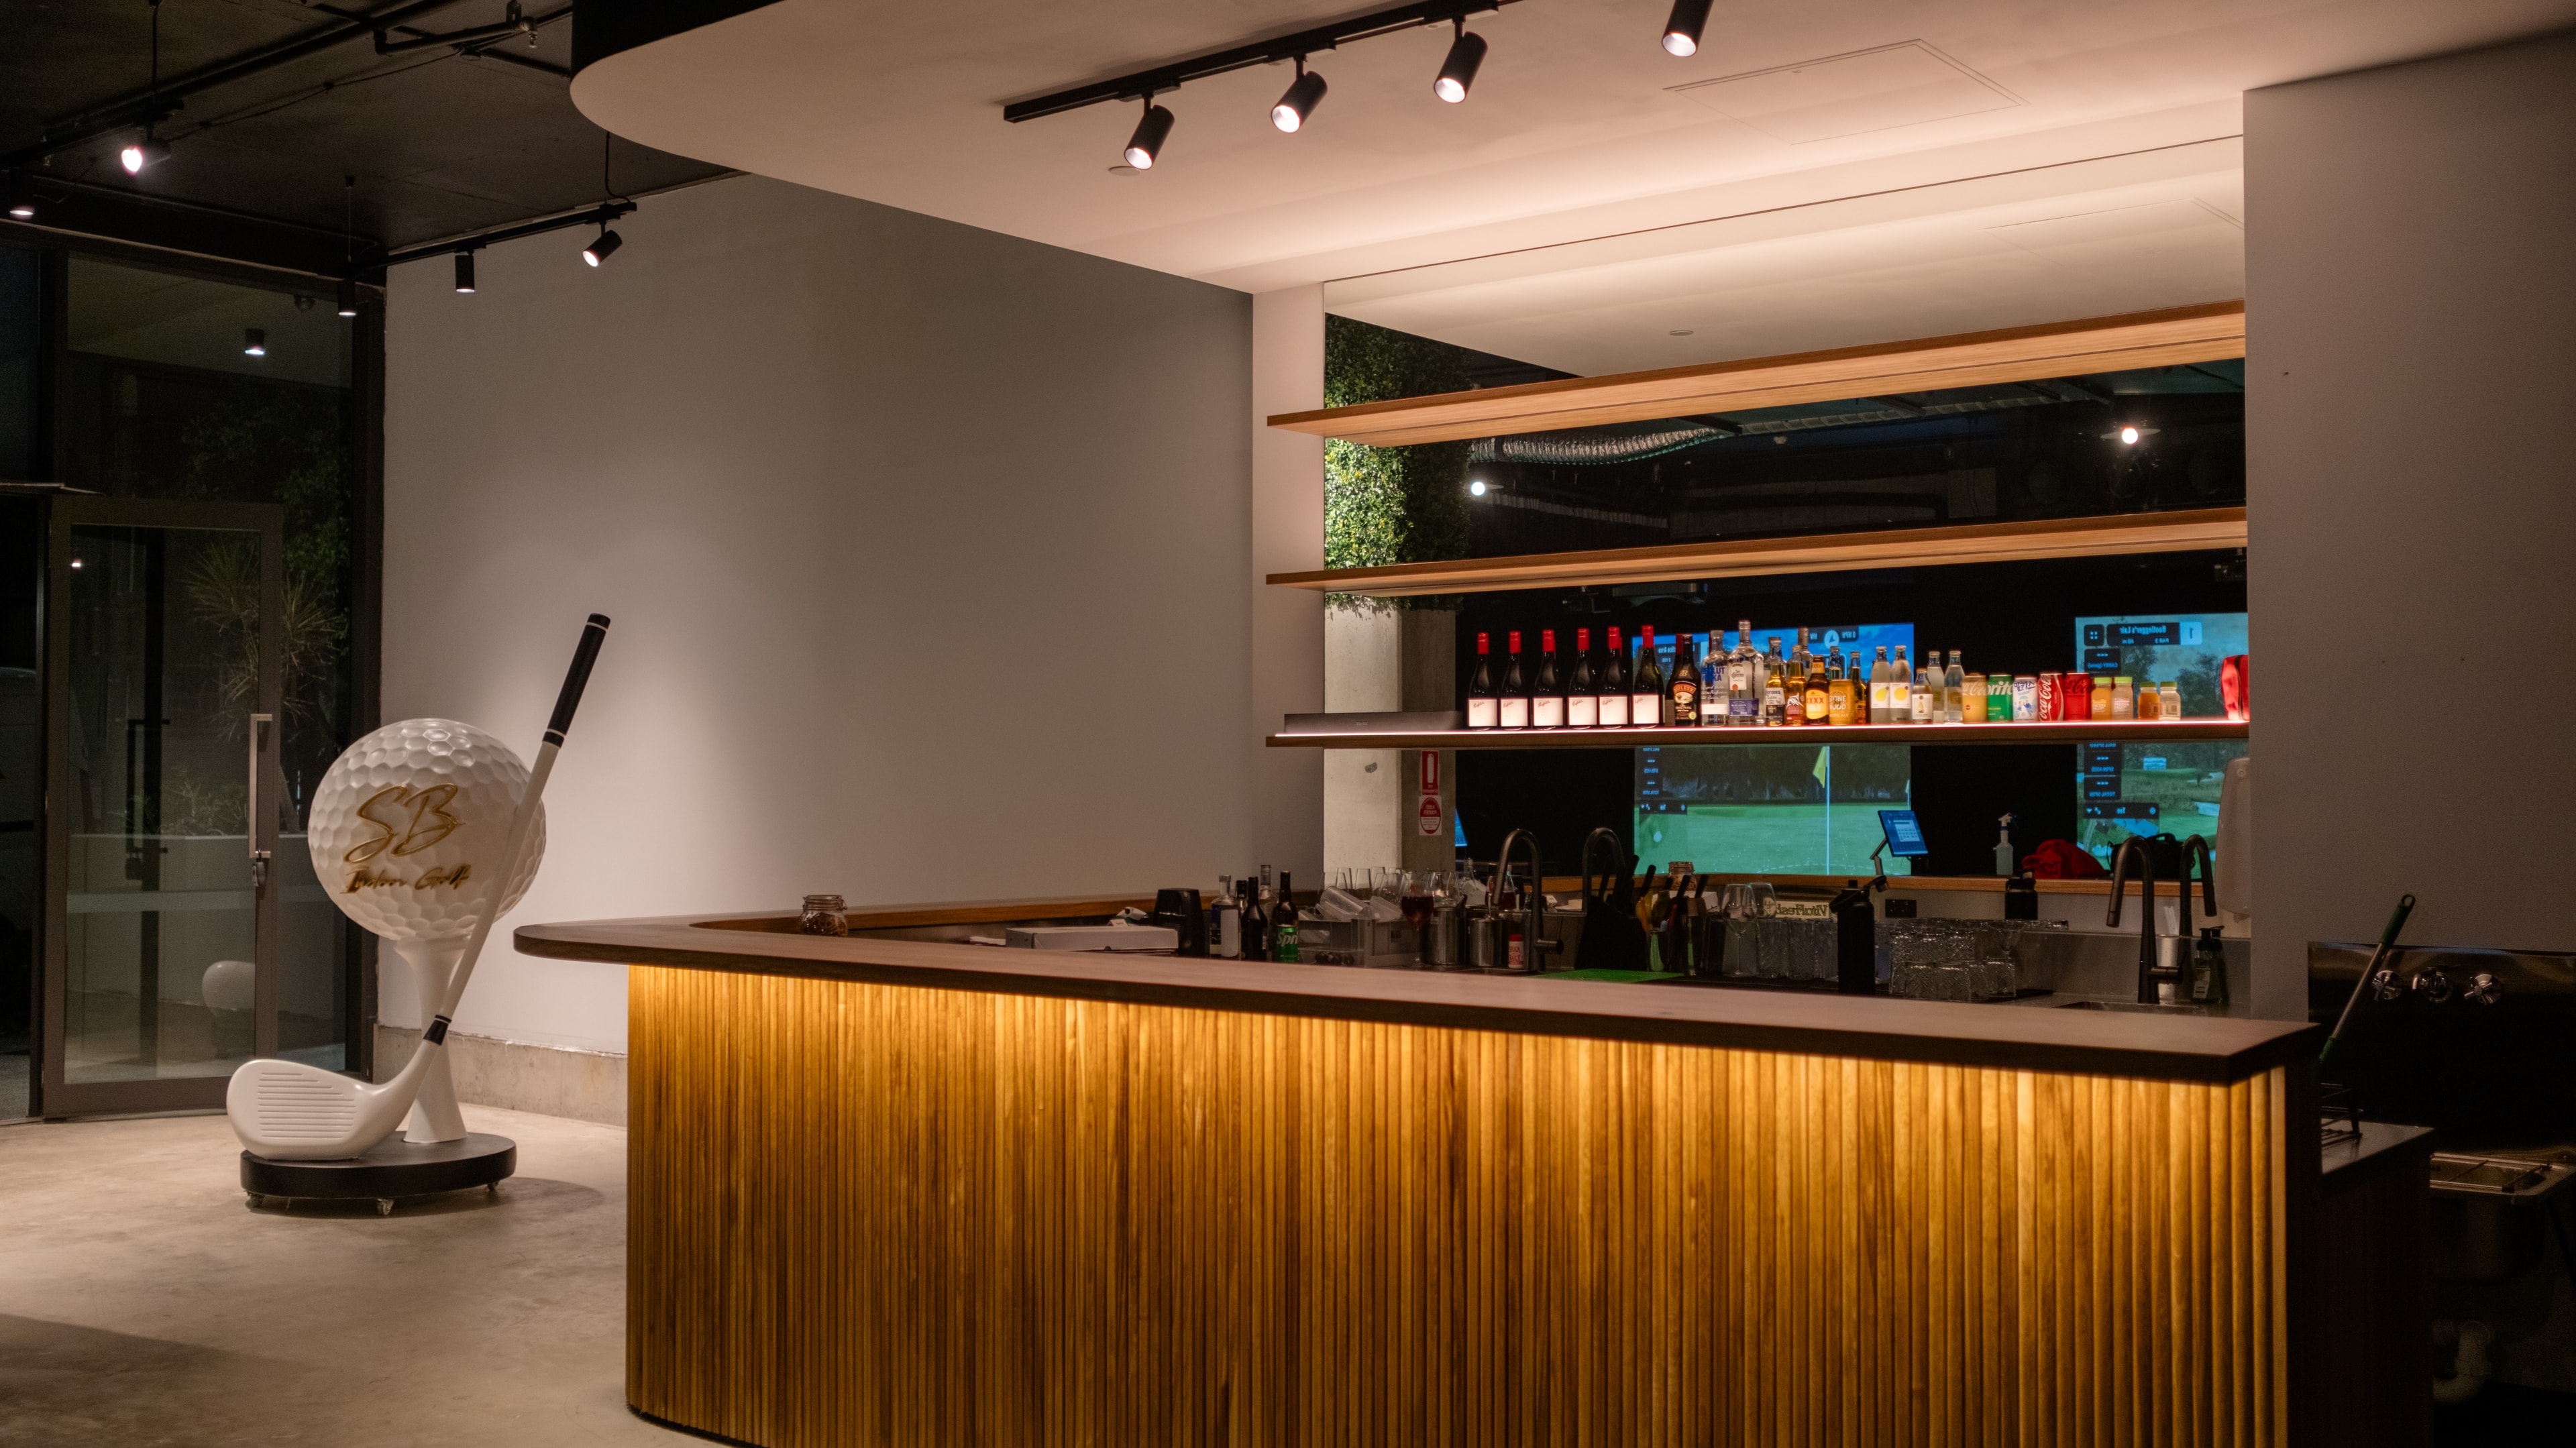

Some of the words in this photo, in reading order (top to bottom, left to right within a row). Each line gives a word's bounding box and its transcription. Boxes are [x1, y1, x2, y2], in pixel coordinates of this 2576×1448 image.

[344, 783, 466, 863] SB
[339, 866, 406, 894] Indoor
[415, 865, 471, 891] Golf
[1277, 932, 1298, 947] Spri
